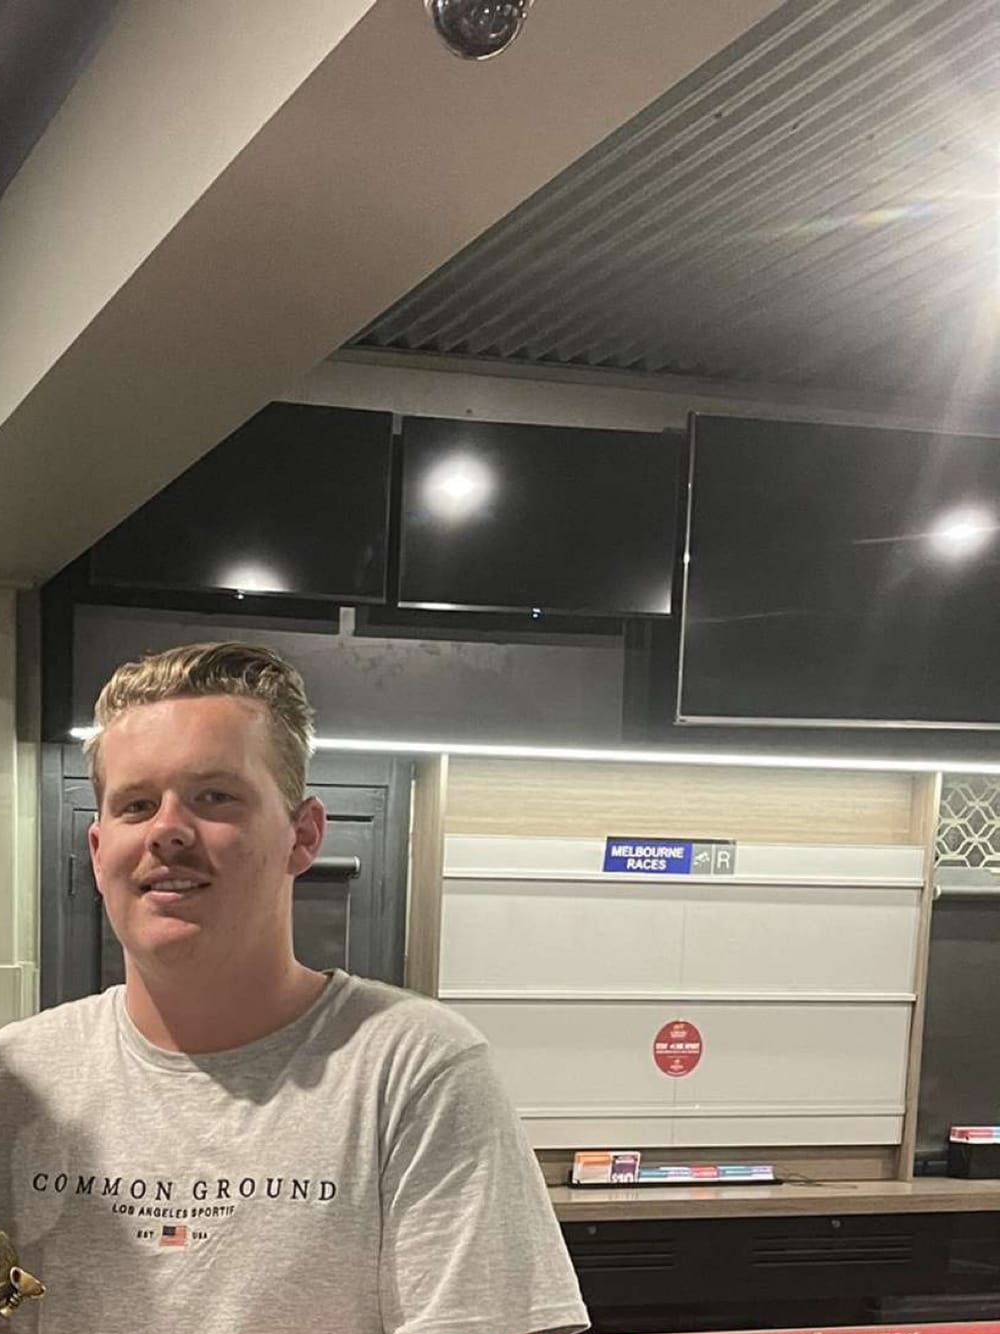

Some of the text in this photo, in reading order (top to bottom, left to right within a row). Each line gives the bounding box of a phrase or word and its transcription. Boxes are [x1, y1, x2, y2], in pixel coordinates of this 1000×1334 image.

[611, 845, 685, 858] MELBOURNE
[627, 858, 667, 870] RACES
[717, 851, 730, 869] R
[32, 1173, 337, 1201] COMMON GROUND
[112, 1203, 235, 1218] LOS ANGELES SPORTIF
[192, 1231, 208, 1239] USA
